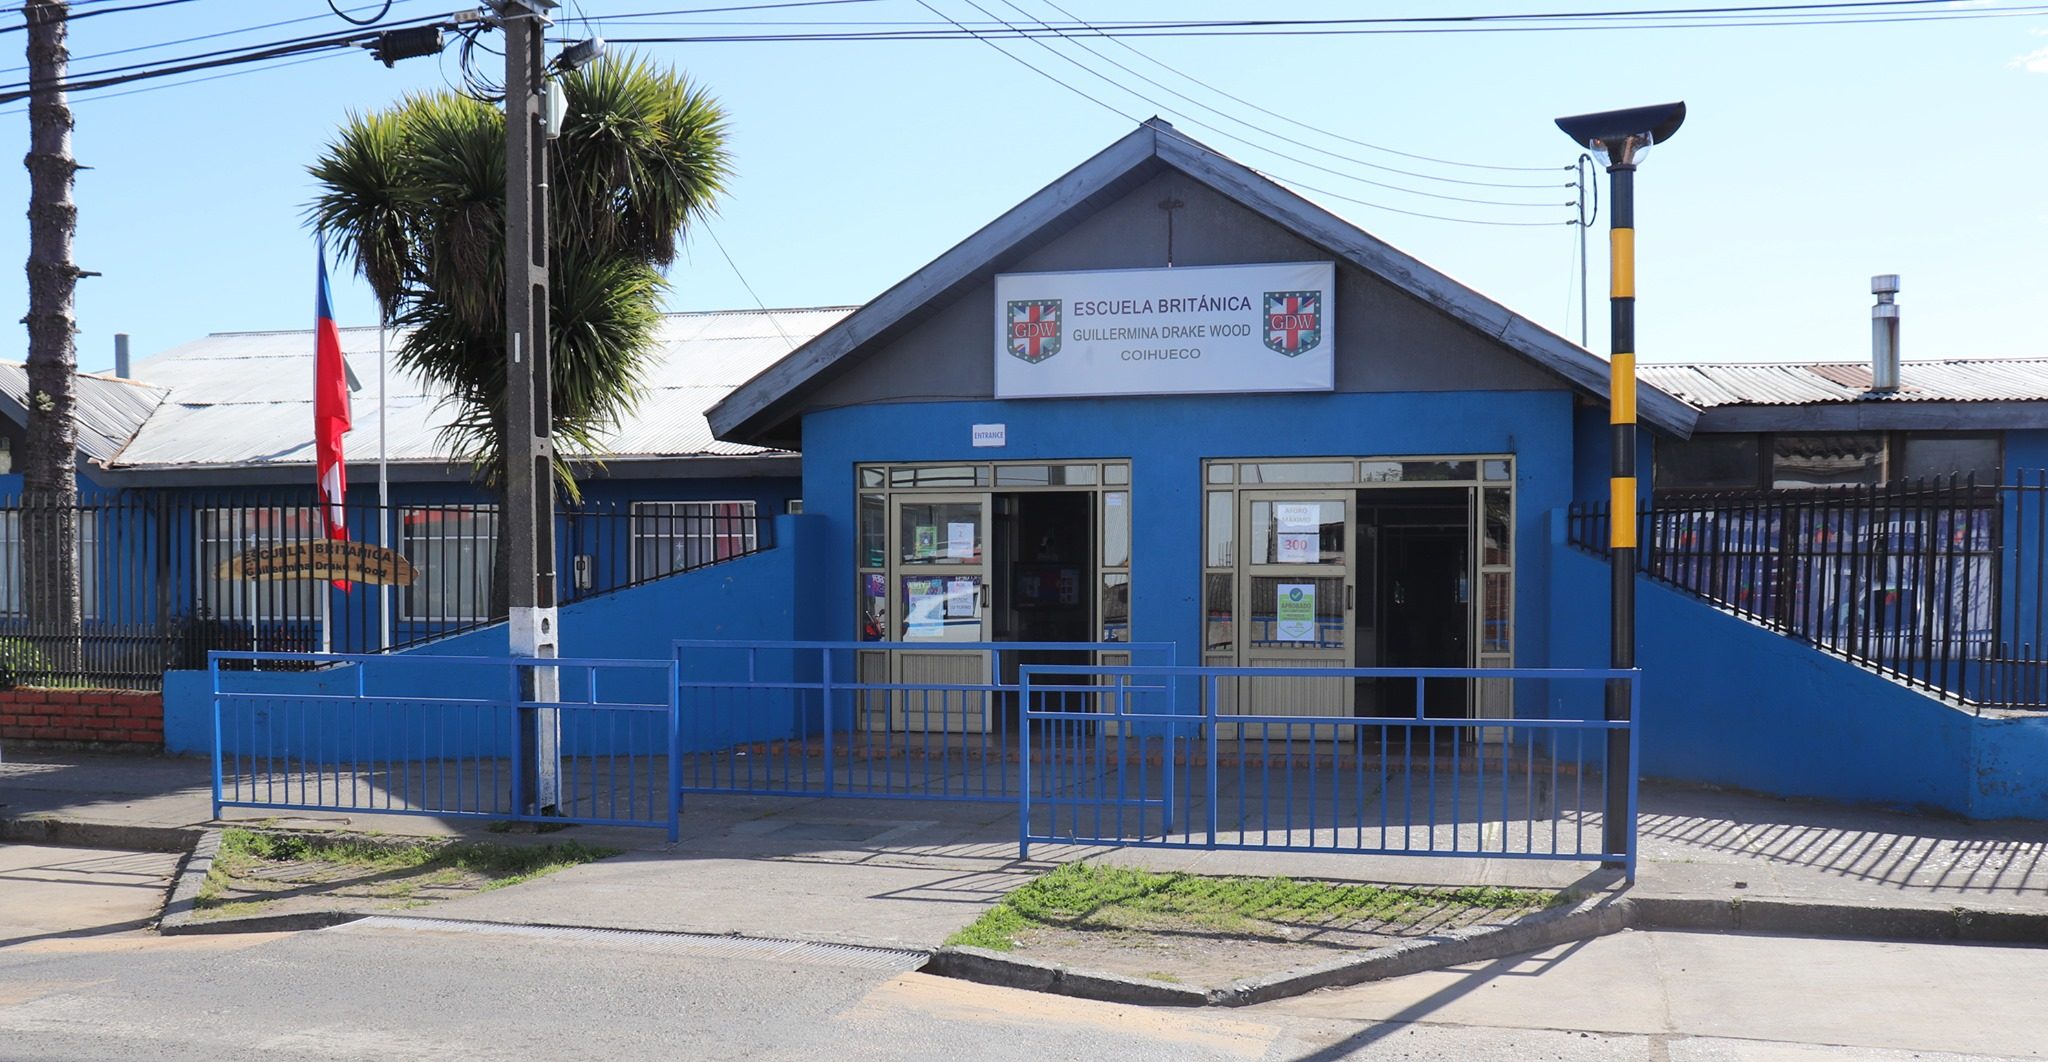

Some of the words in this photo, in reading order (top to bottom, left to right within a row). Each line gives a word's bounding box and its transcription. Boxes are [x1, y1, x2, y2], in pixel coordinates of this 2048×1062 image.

[1073, 299, 1153, 317] ESCUELA
[1158, 294, 1251, 313] BRITÁNICA
[1014, 321, 1056, 338] GDW
[1270, 314, 1313, 331] GDW
[1072, 327, 1158, 342] GUILLERMINA
[1162, 325, 1205, 339] DRAKE
[1209, 324, 1251, 338] WOOD
[1120, 348, 1201, 361] COIHUECO
[974, 431, 1004, 440] ENTRANCE
[1284, 539, 1308, 551] 300
